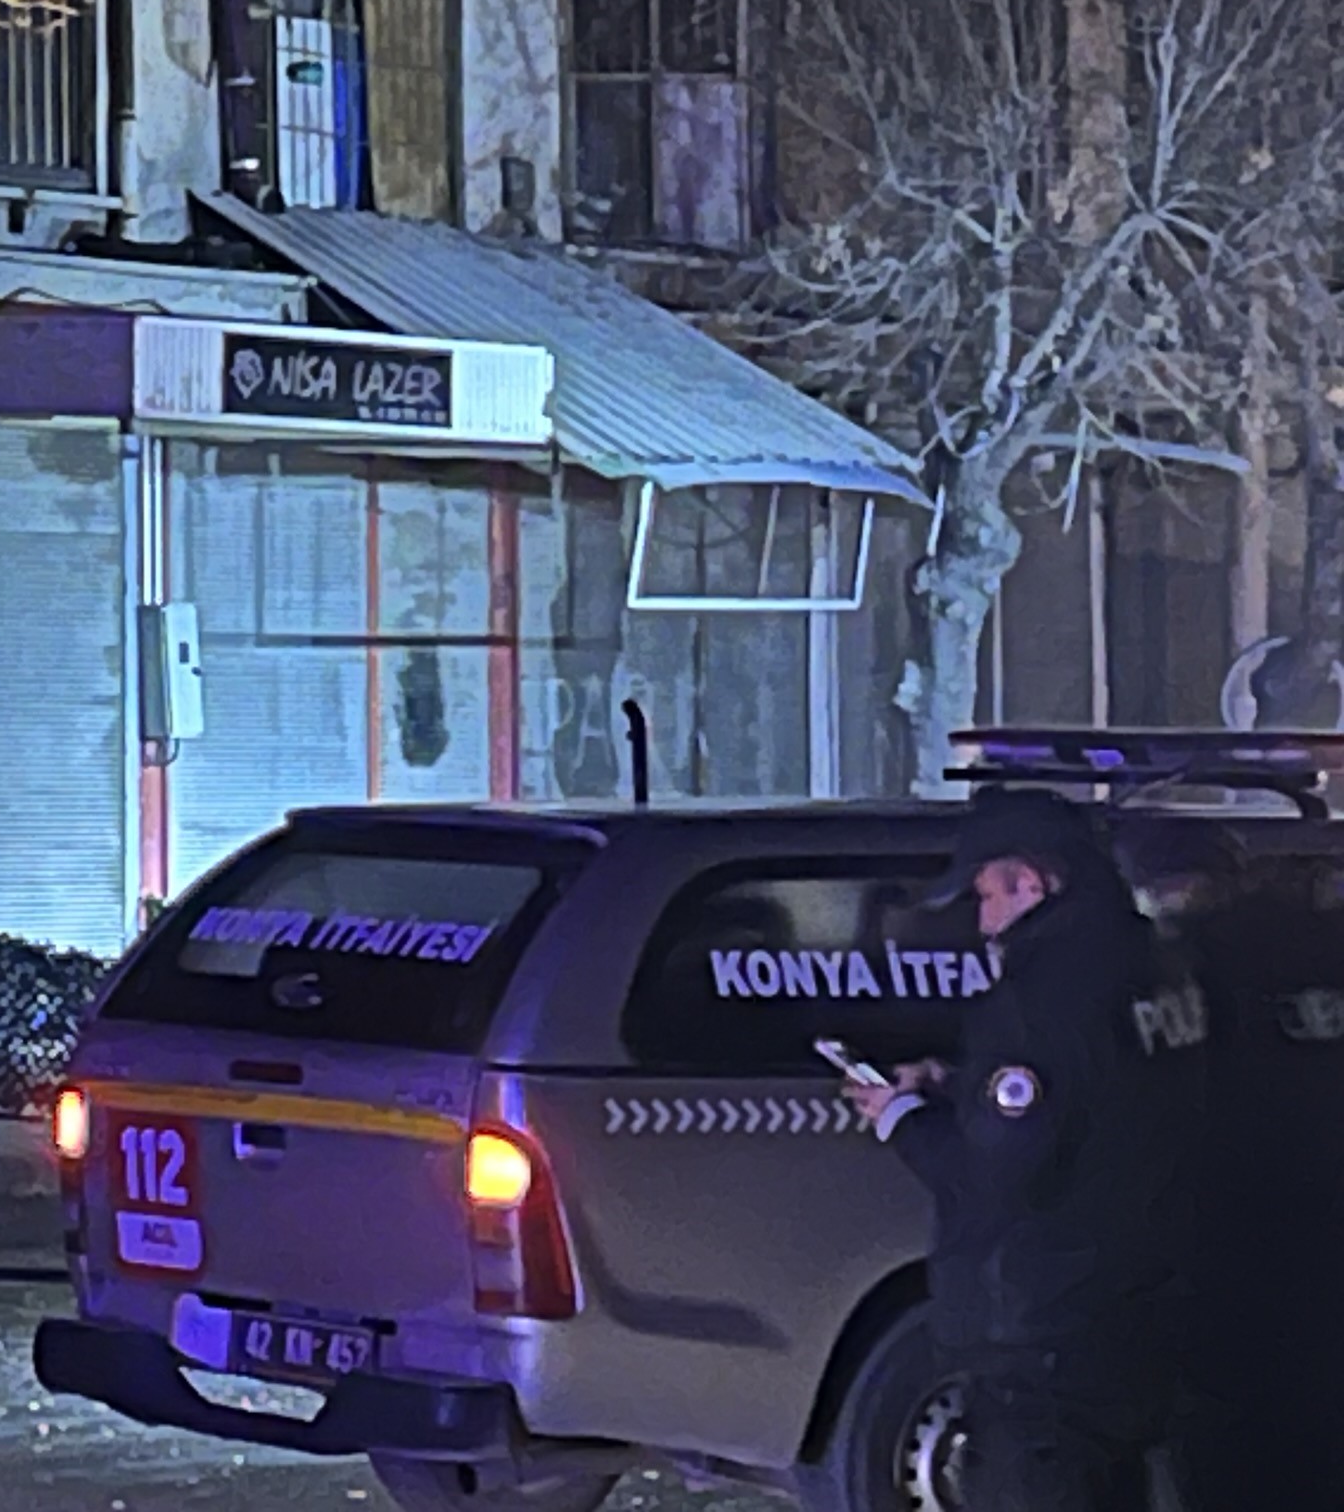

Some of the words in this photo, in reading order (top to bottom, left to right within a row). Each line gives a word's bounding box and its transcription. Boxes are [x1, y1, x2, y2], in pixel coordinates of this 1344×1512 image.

[352, 359, 442, 408] LAZER
[188, 906, 312, 947] KONYA
[710, 949, 882, 998] KONYA
[120, 1125, 189, 1207] 112
